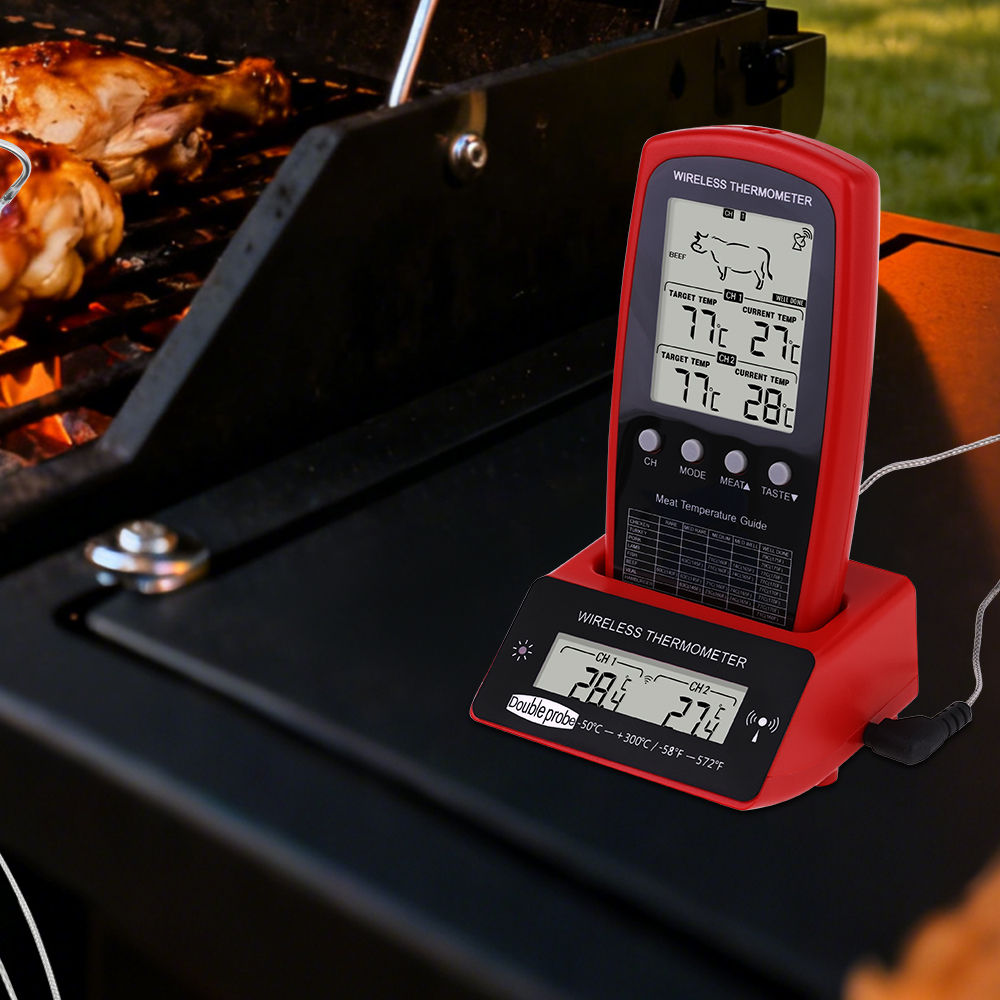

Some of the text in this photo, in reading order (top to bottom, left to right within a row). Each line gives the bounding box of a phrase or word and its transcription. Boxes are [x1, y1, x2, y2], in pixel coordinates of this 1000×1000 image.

[673, 170, 813, 207] WIRELESS THERMOMETER
[668, 251, 686, 260] BEEF
[669, 290, 718, 306] TARGET TEMP
[742, 306, 797, 323] CURRENT TEMP
[662, 351, 710, 368] TARGET TEMP
[735, 368, 790, 386] CURRENT TEMP
[644, 457, 657, 467] CH
[680, 466, 706, 480] MODE
[720, 476, 744, 489] MEAT
[762, 486, 790, 501] TASTE
[656, 494, 768, 531] Meat Temperature Guide
[578, 610, 748, 668] WIRELESS THERMOMETER
